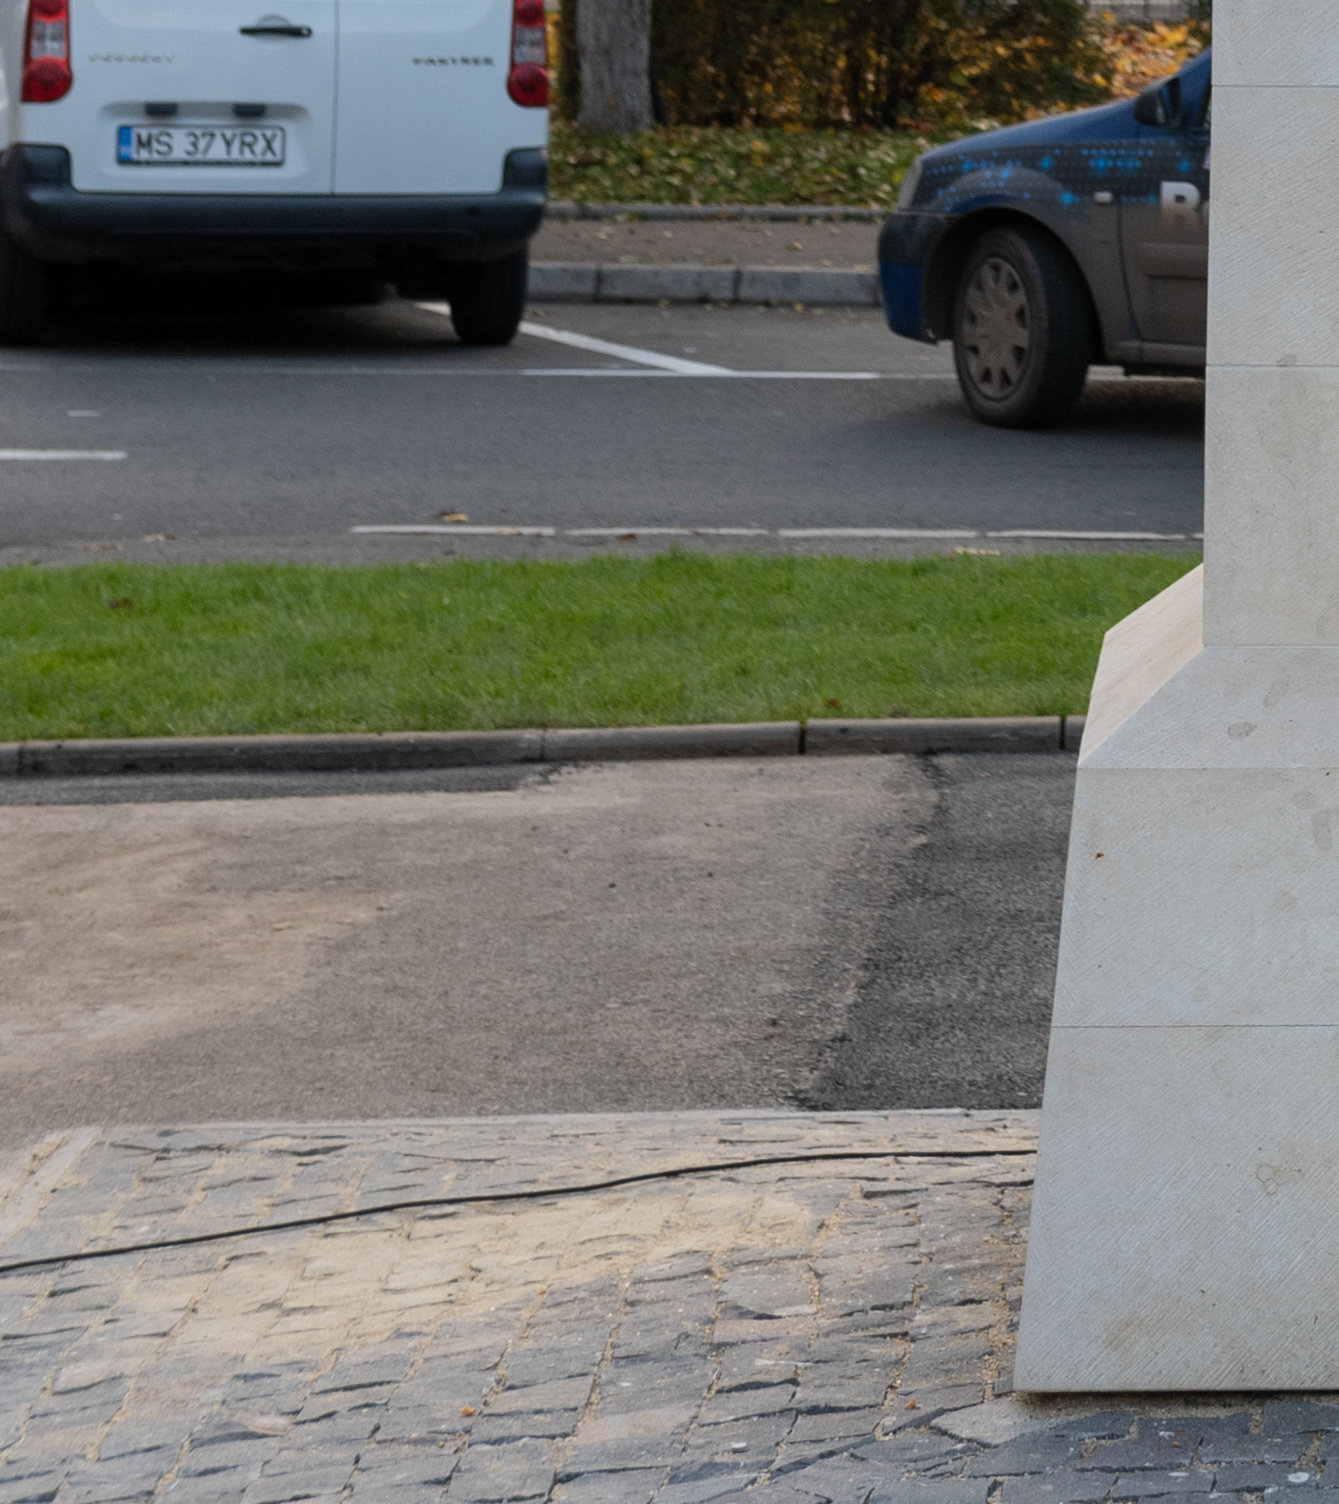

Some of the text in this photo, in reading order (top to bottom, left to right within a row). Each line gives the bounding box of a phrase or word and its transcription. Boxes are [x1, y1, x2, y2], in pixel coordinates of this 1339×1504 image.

[136, 130, 278, 156] MS 37 YRX
